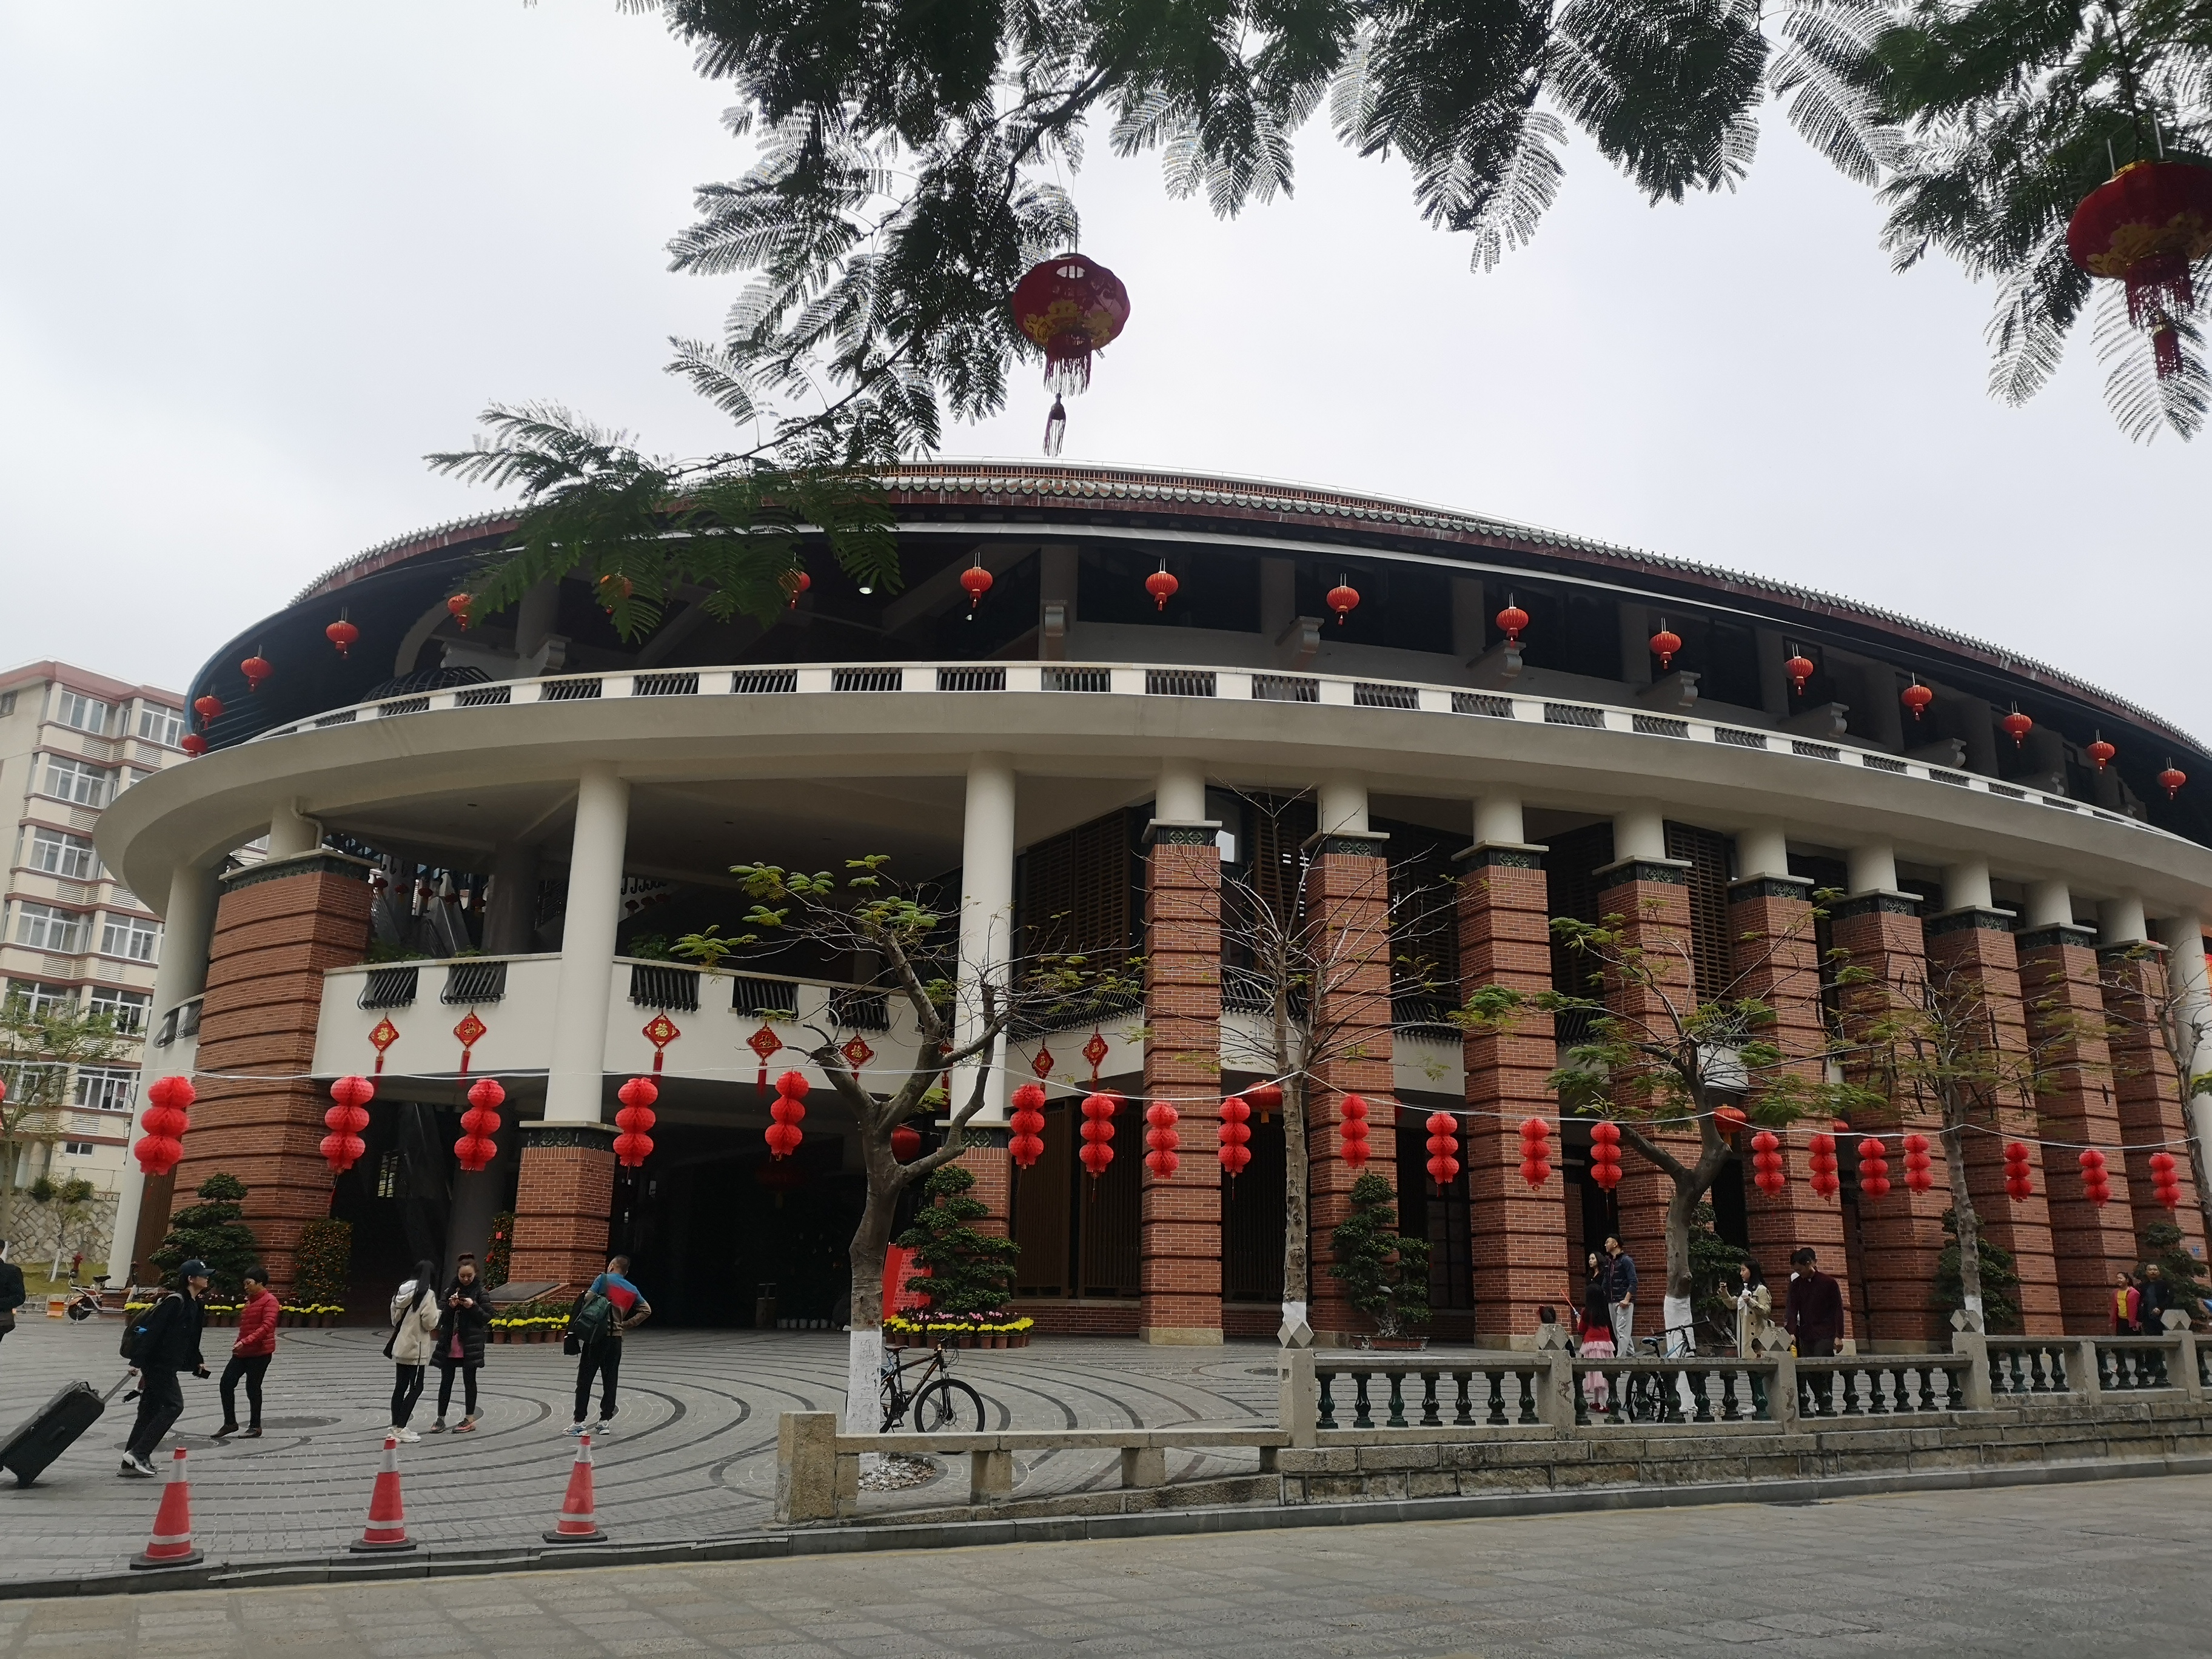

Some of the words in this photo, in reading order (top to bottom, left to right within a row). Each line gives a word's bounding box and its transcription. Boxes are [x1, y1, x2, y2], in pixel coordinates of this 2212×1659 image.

[378, 1027, 389, 1041] 福
[464, 1022, 475, 1036] 福
[655, 1023, 668, 1037] 福
[851, 1045, 863, 1058] 福
